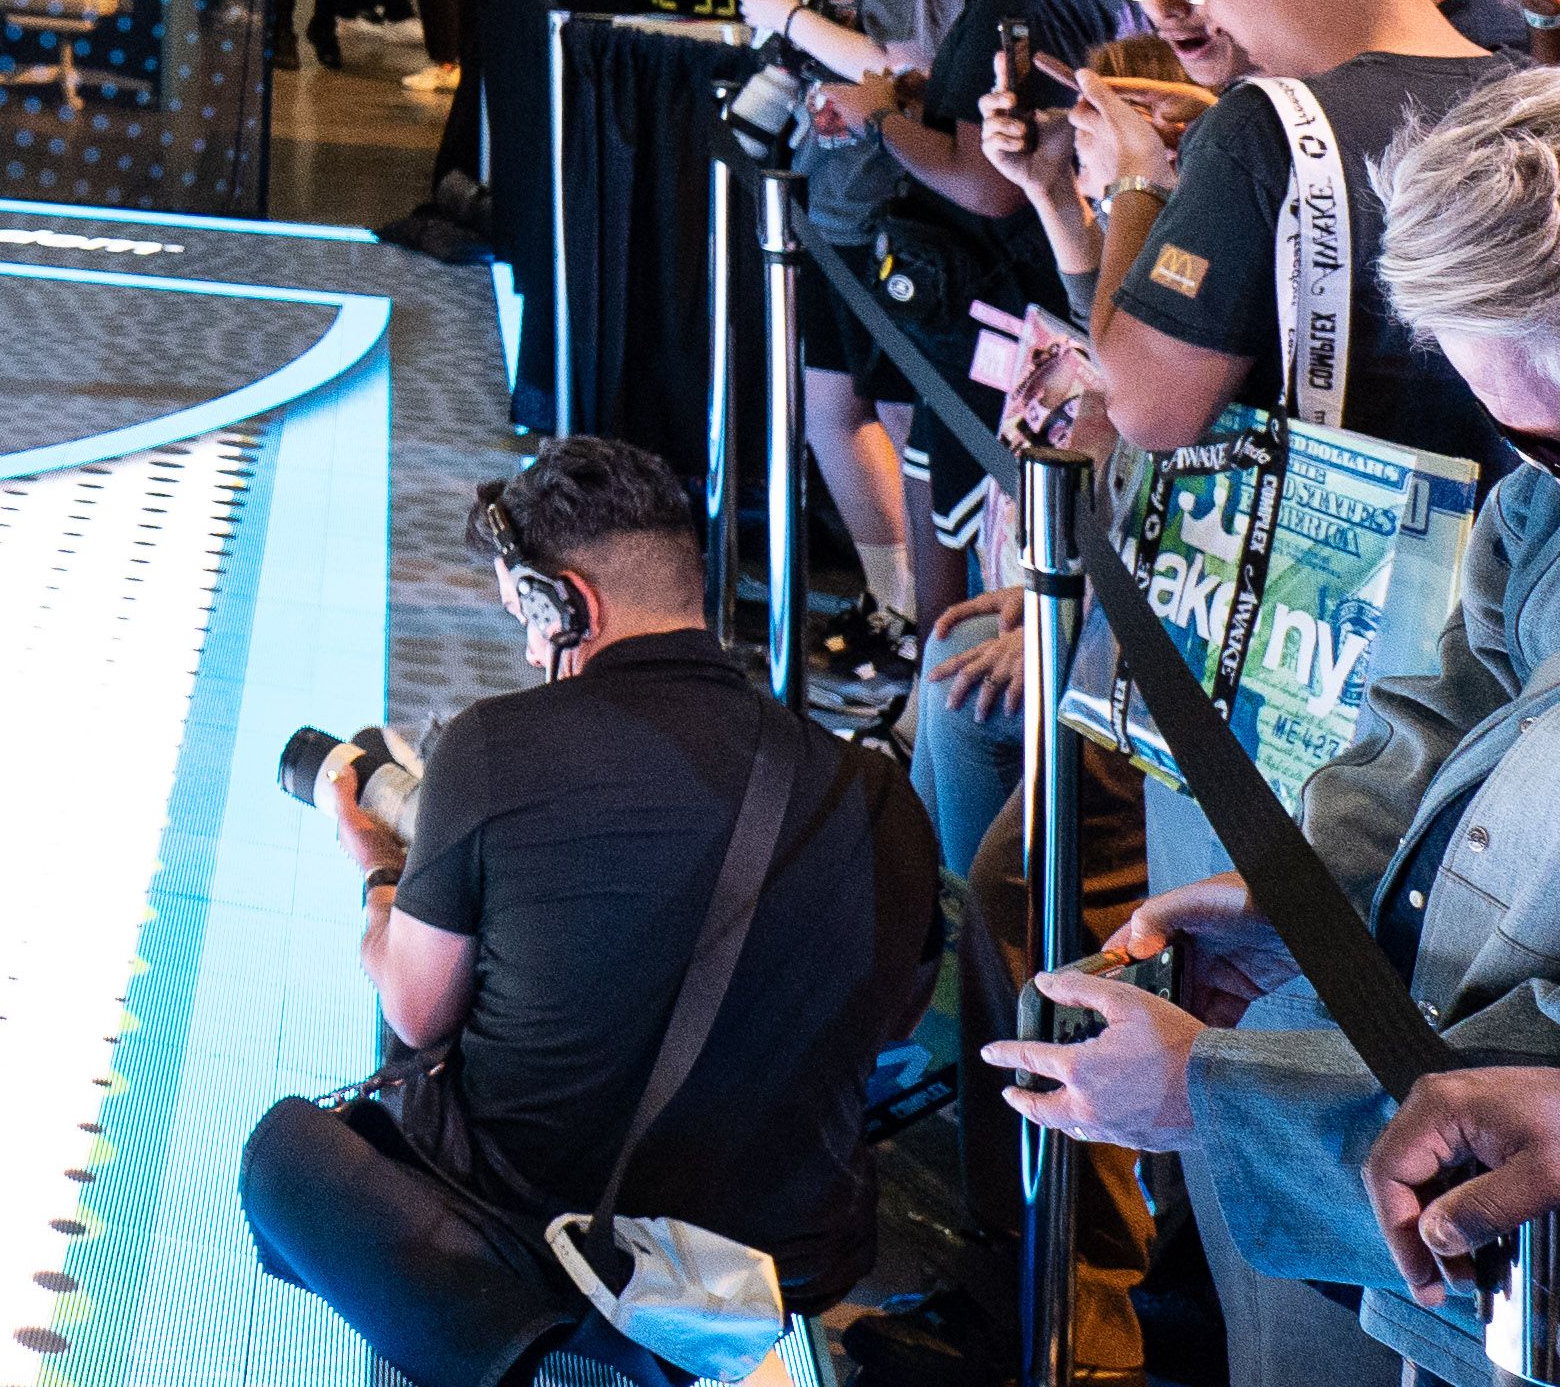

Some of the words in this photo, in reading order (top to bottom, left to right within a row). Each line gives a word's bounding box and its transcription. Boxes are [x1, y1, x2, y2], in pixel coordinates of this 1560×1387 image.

[1308, 311, 1339, 392] COMPLEX
[1250, 474, 1279, 556] COMPLEX
[1296, 480, 1398, 537] STATES
[1262, 603, 1371, 717] ny
